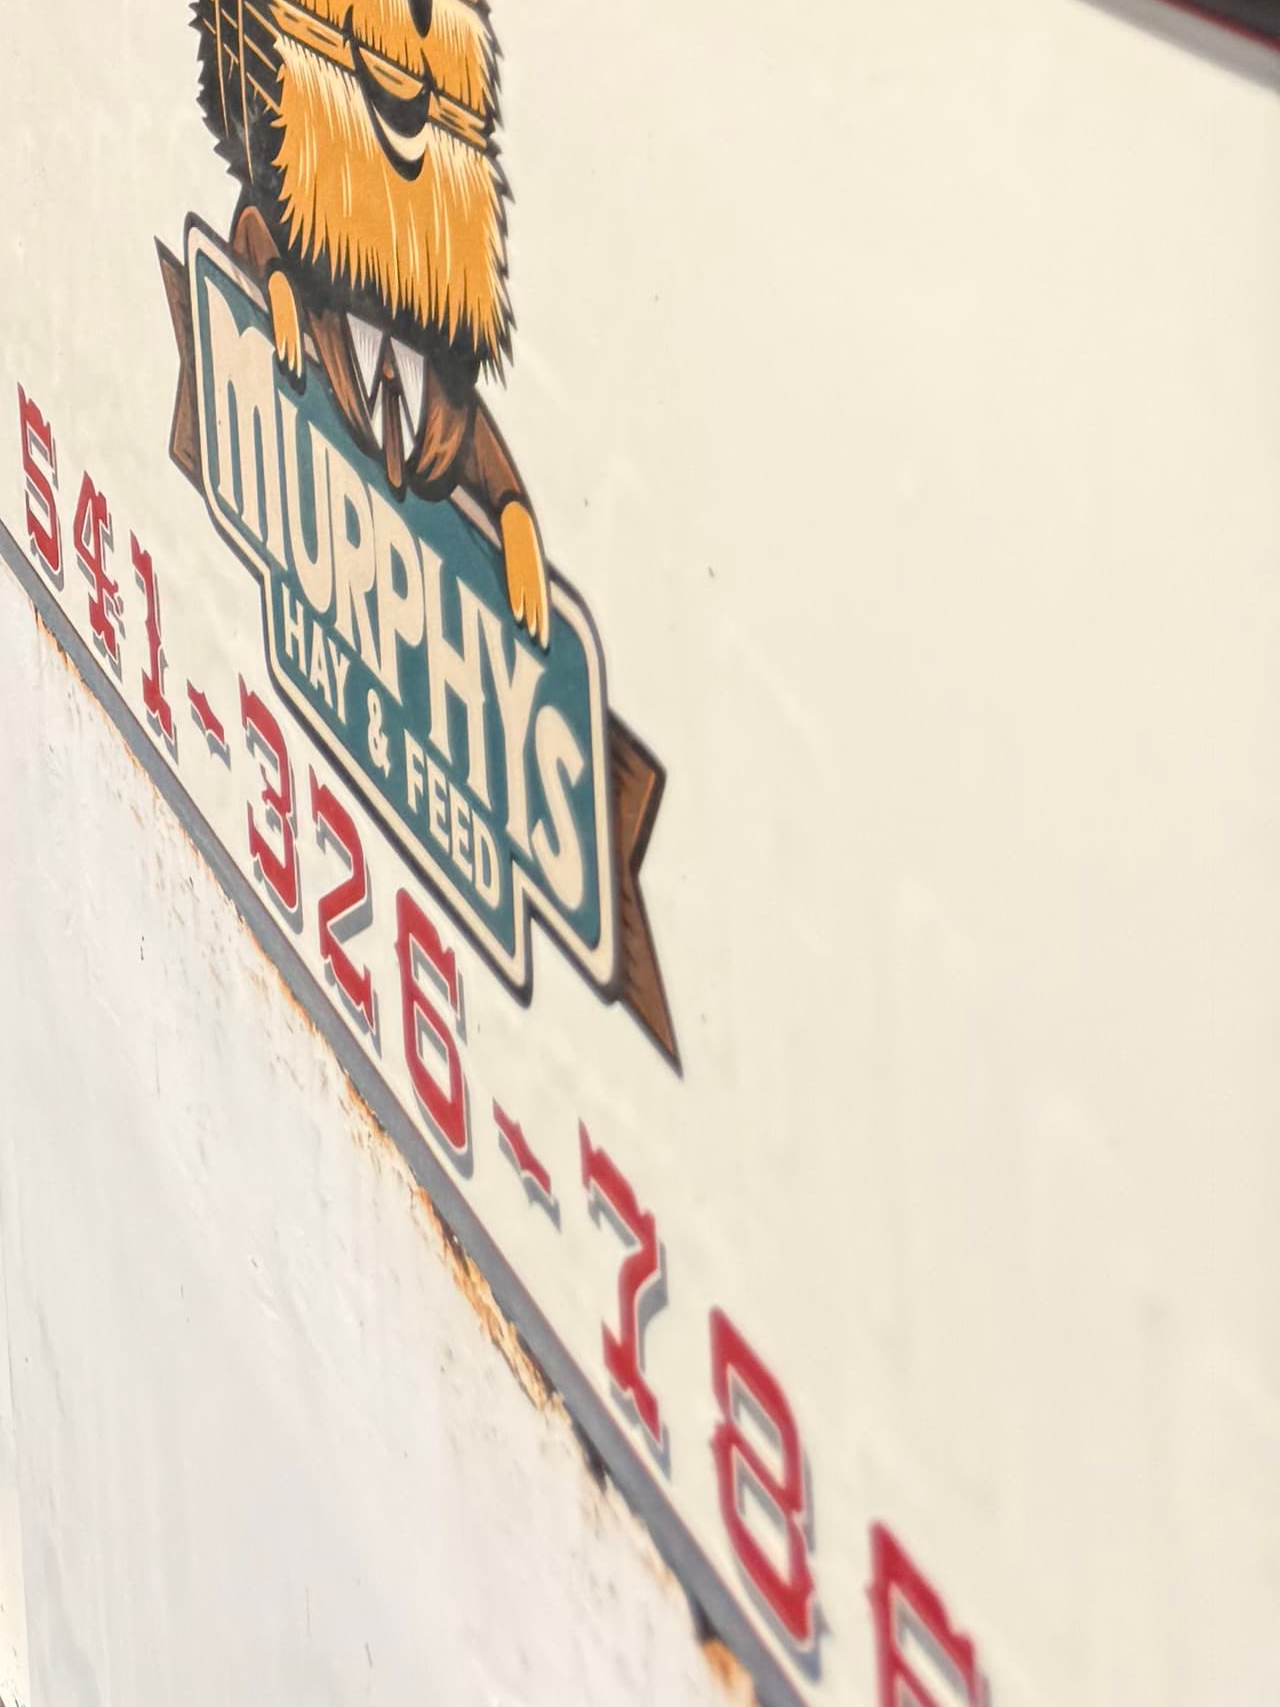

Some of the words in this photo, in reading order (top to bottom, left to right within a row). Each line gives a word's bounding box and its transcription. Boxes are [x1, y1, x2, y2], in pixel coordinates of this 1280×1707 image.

[204, 275, 585, 913] MURPHYS
[282, 582, 352, 725] HAY
[366, 689, 390, 779] &
[404, 729, 501, 910] FEED
